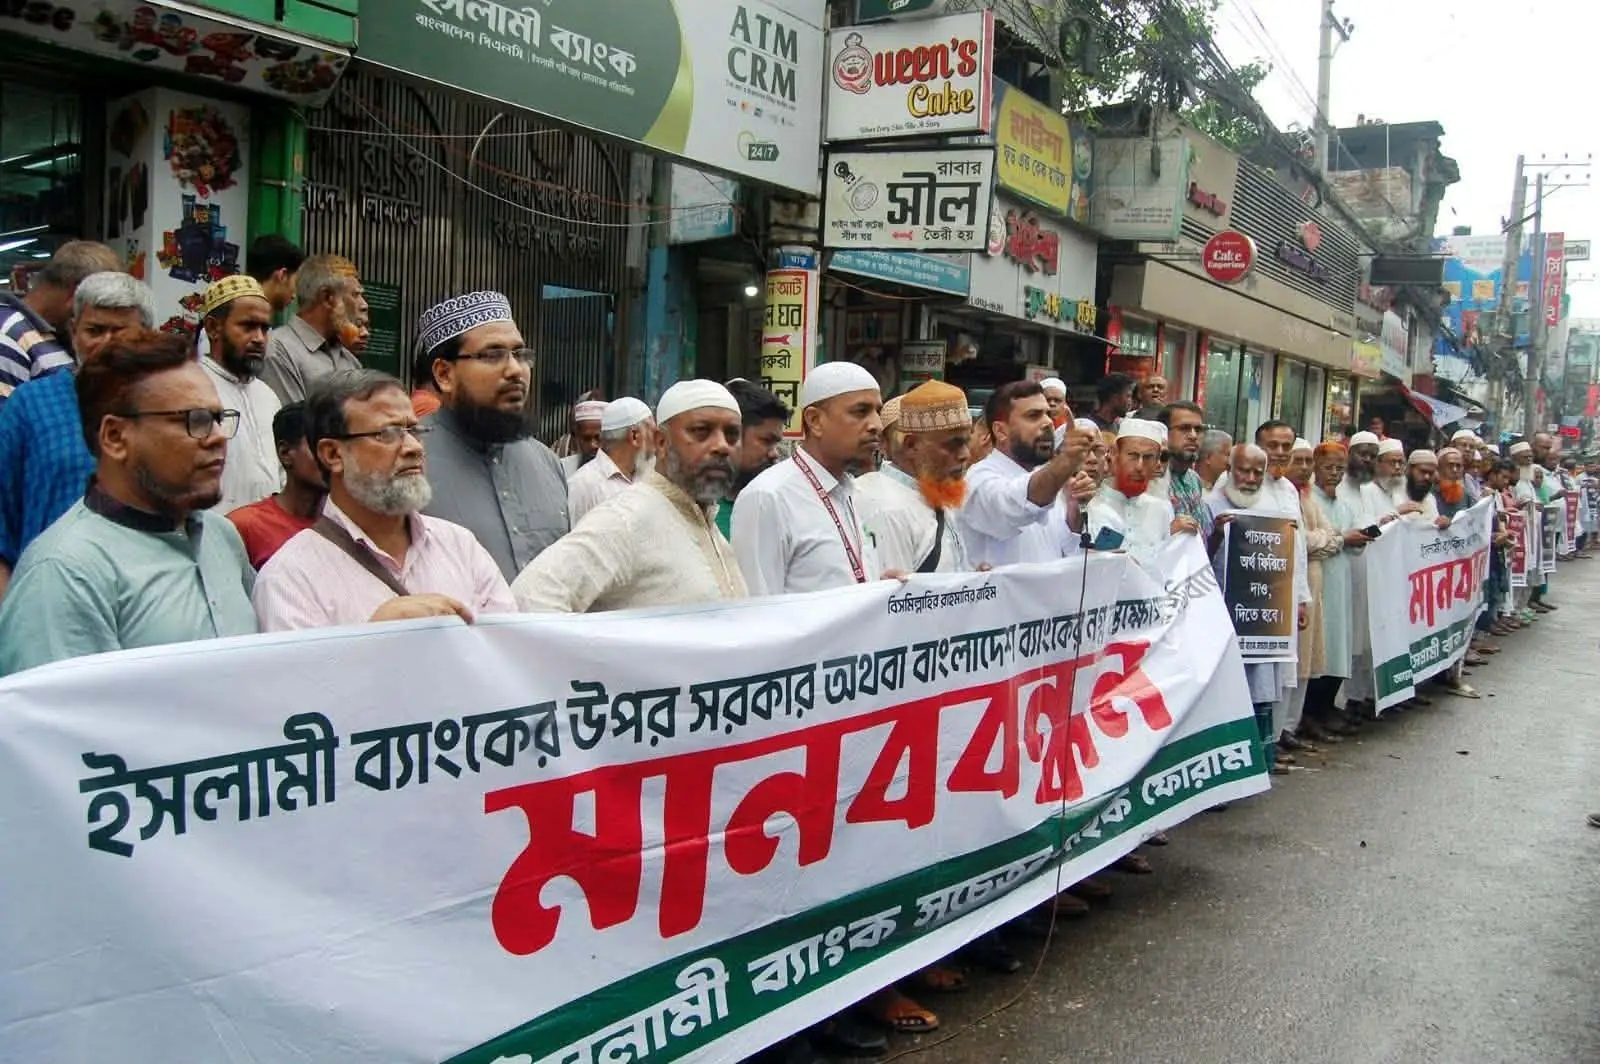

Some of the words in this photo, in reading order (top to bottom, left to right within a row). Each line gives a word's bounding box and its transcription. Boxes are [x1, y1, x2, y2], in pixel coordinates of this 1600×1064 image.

[415, 13, 475, 44] বাংলাদেশ
[550, 24, 638, 78] ব্যাংক
[730, 5, 798, 65] ATM
[727, 47, 797, 103] CRM
[907, 80, 976, 118] Cake
[751, 146, 775, 159] 24/7
[936, 160, 983, 176] রাবার
[886, 171, 982, 226] সীল
[80, 711, 340, 858] ইসলামী
[351, 701, 560, 792] ব্যাংকের
[566, 680, 681, 751] উপর
[689, 663, 816, 735] সরকার
[823, 646, 908, 705] অথবা
[911, 622, 1017, 684] বাংলাদেশ
[485, 636, 1174, 957] মানববন্ধন
[748, 904, 902, 995] ব্যাংক
[1141, 740, 1253, 806] ফোরাম
